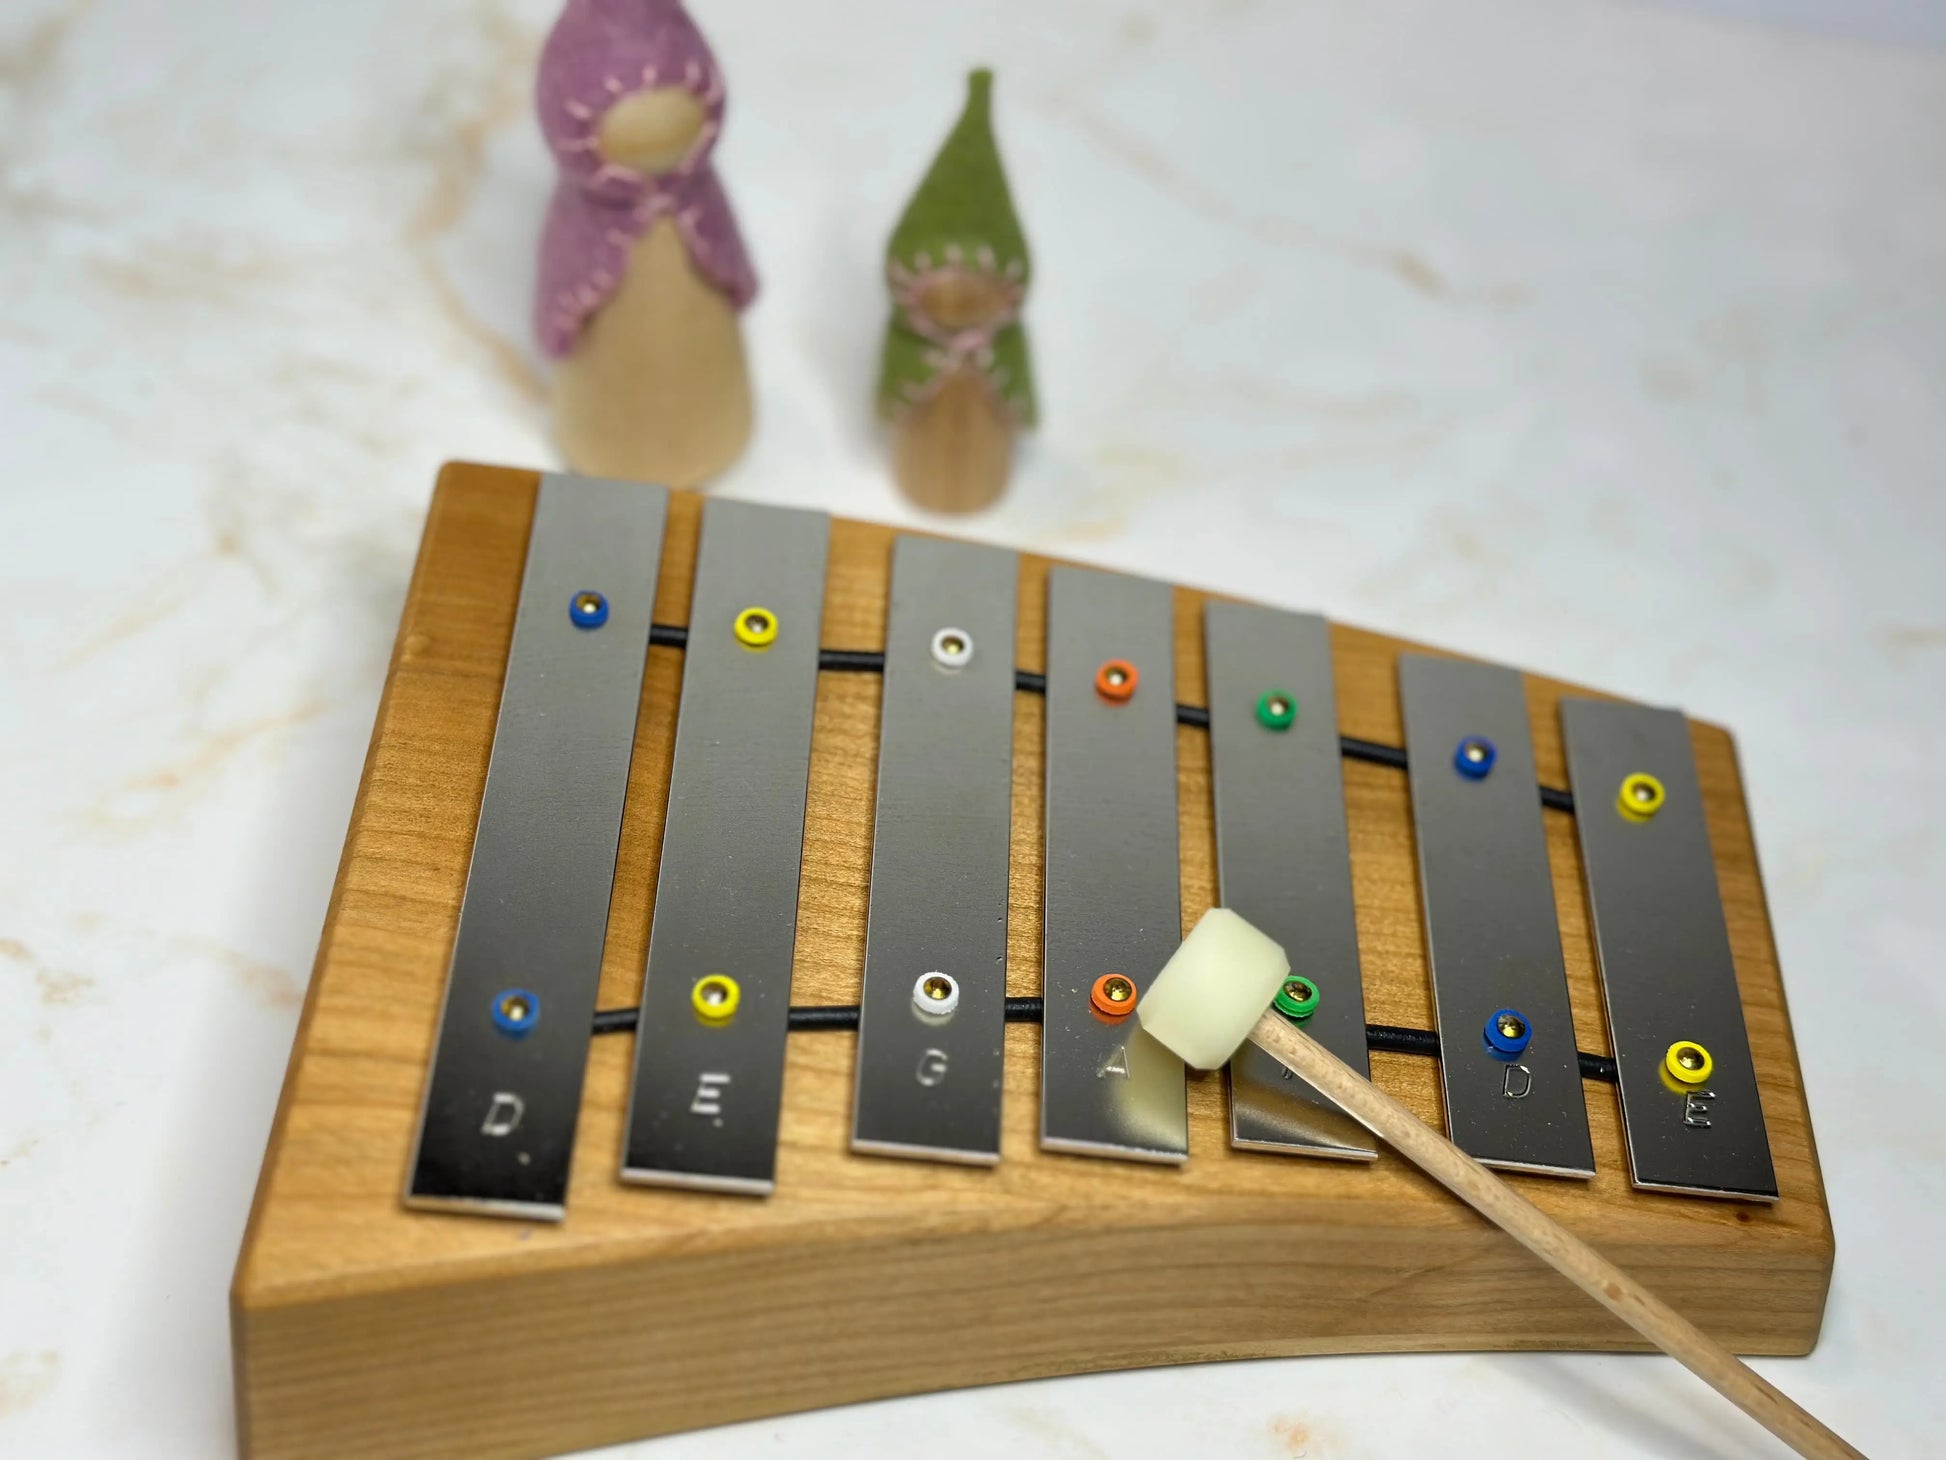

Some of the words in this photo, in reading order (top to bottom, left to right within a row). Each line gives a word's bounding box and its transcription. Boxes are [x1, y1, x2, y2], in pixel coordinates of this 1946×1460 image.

[916, 1048, 948, 1086] G
[1097, 1046, 1130, 1079] A
[1503, 1063, 1532, 1099] D
[1682, 1090, 1716, 1129] E
